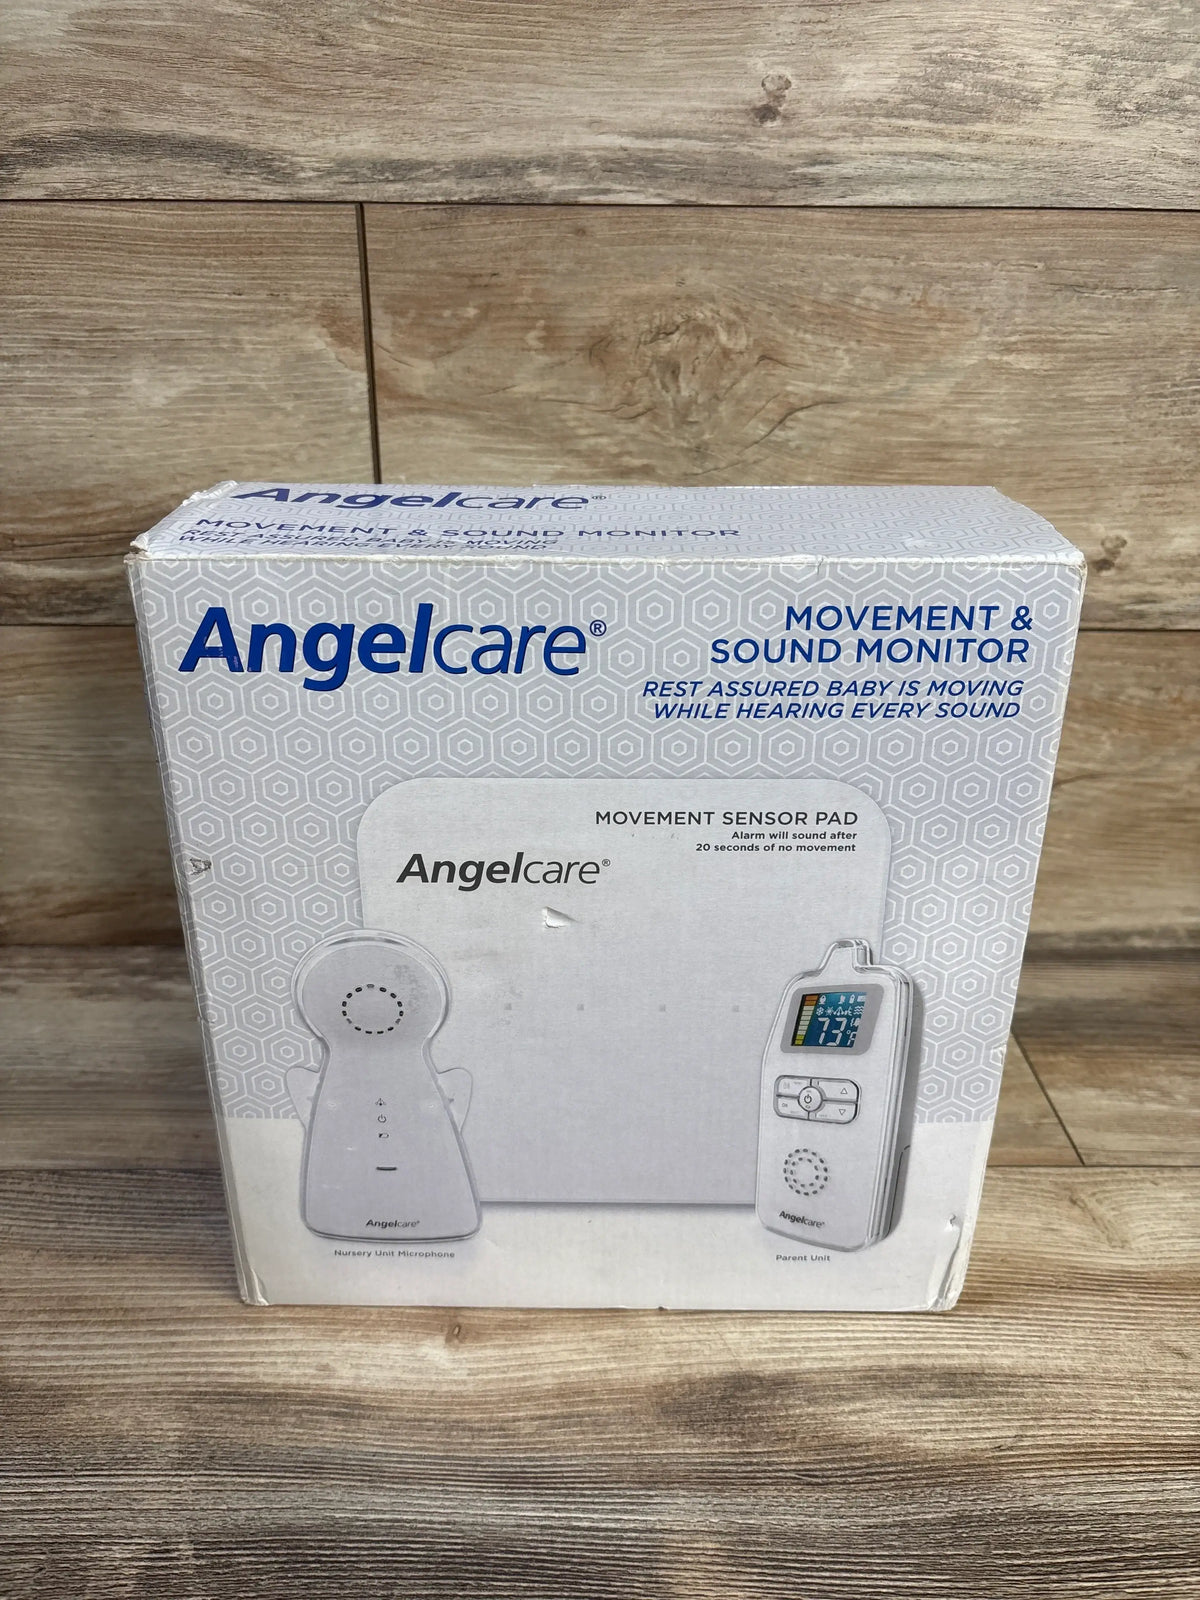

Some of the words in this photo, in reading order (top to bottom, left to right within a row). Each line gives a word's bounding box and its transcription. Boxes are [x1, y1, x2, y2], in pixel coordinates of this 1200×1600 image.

[182, 529, 245, 538] REST
[248, 533, 359, 542] ASSURED
[195, 519, 398, 535] MOVEMENT
[408, 529, 427, 537] &
[442, 529, 564, 537] SOUND
[578, 529, 740, 537] MONITOR
[179, 535, 256, 545] WHILE
[261, 539, 371, 548] HEARING
[785, 605, 999, 631] MOVEMENT
[1011, 606, 1033, 631] &
[710, 638, 842, 664] SOUND
[856, 638, 1030, 663] MONITOR
[642, 681, 703, 697] REST
[707, 681, 819, 697] ASSURED
[826, 681, 893, 697] BABY
[898, 681, 920, 697] IS
[927, 681, 1024, 697] MOVING
[654, 703, 731, 719] WHILE
[736, 703, 843, 719] HEARING
[850, 703, 932, 719] EVERY
[935, 702, 1020, 718] SOUND
[595, 811, 715, 826] MOVEMENT
[722, 811, 808, 826] SENSOR
[815, 811, 858, 826] PAD
[731, 831, 765, 840] Alarm
[769, 831, 789, 840] will
[792, 831, 827, 840] sound
[830, 831, 858, 840] after
[696, 843, 711, 852] 20
[714, 843, 760, 852] seconds
[763, 843, 776, 852] of
[778, 844, 793, 852] no
[796, 844, 856, 852] movement
[817, 1017, 847, 1047] 73
[334, 1250, 372, 1258] Nursery
[398, 1250, 455, 1258] Microphone
[775, 1254, 808, 1262] Parent
[810, 1254, 831, 1262] Unit
